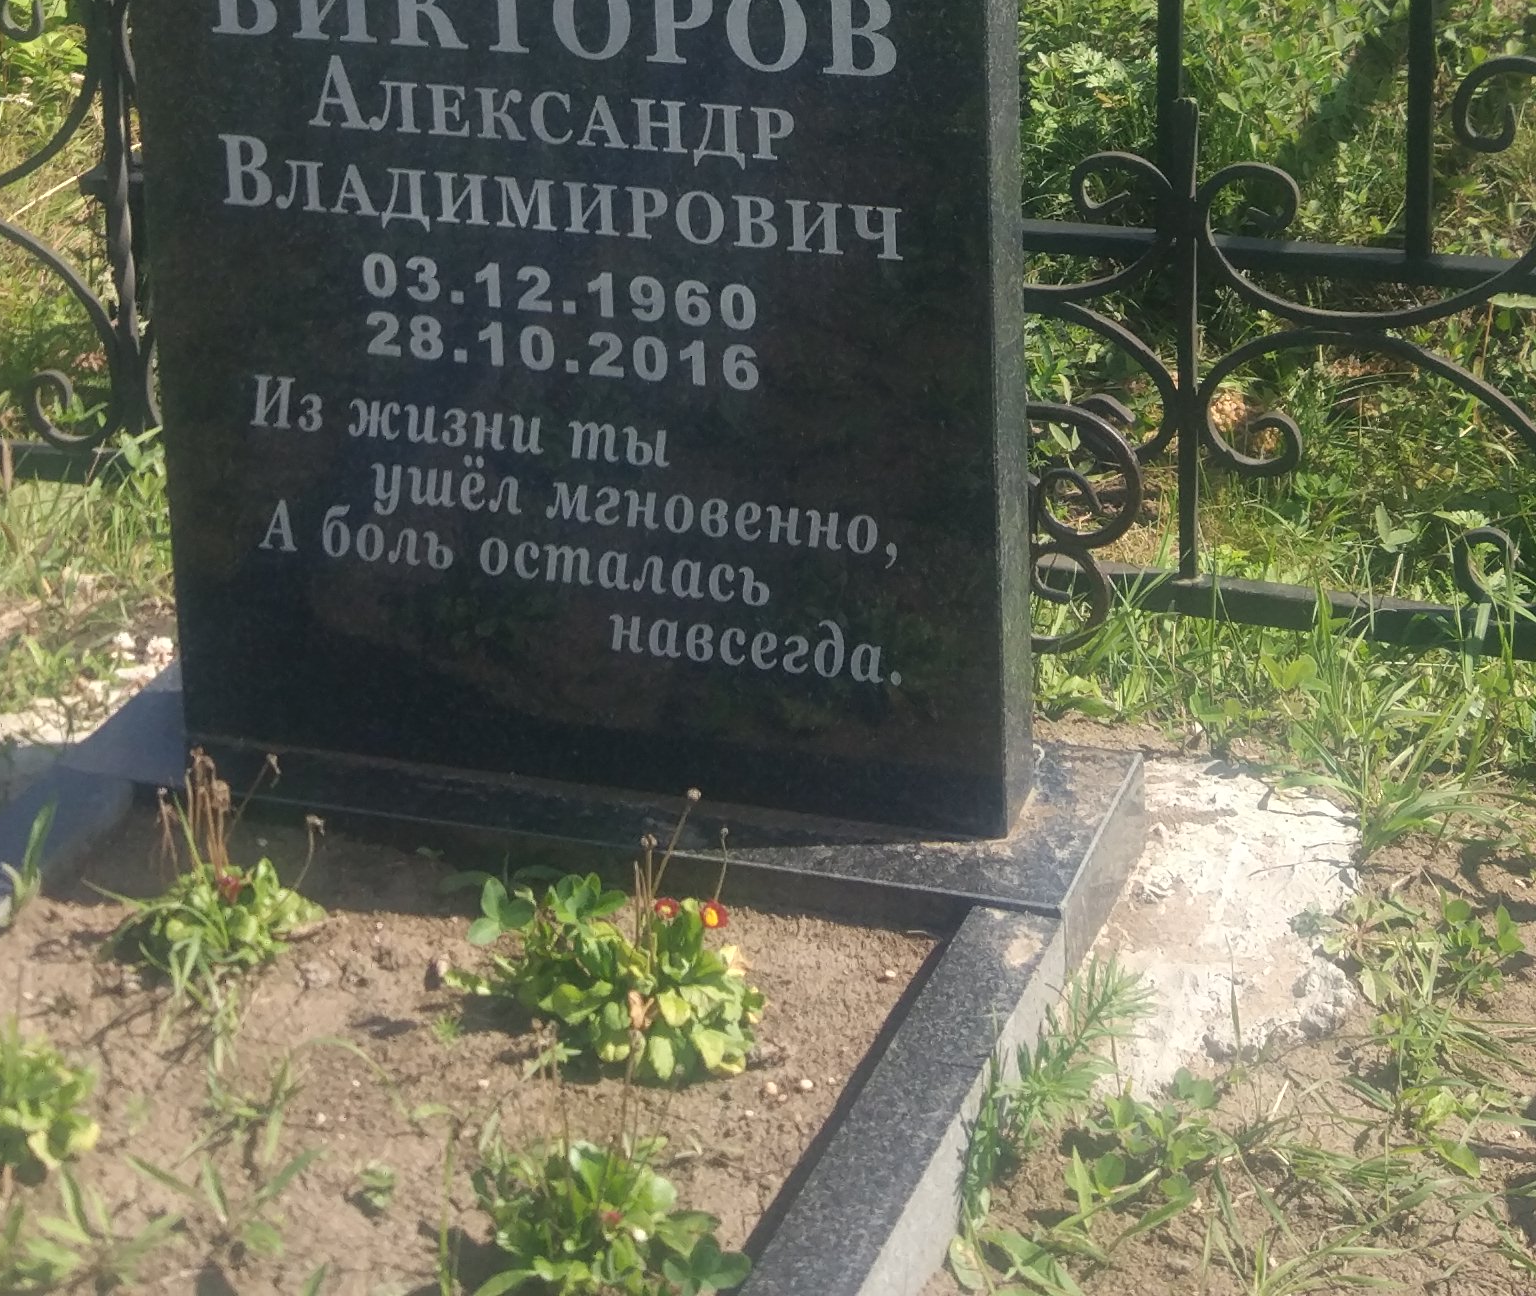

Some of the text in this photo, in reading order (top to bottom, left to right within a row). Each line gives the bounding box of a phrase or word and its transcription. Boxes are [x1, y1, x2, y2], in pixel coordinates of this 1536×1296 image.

[362, 252, 757, 331] 03.12.1960
[366, 310, 760, 391] 28.10.2016
[250, 374, 670, 468] Из жизни ты
[258, 499, 771, 607] А боль осталась
[370, 454, 899, 570] ушёл мгновенно,
[609, 613, 903, 687] навсегда.
